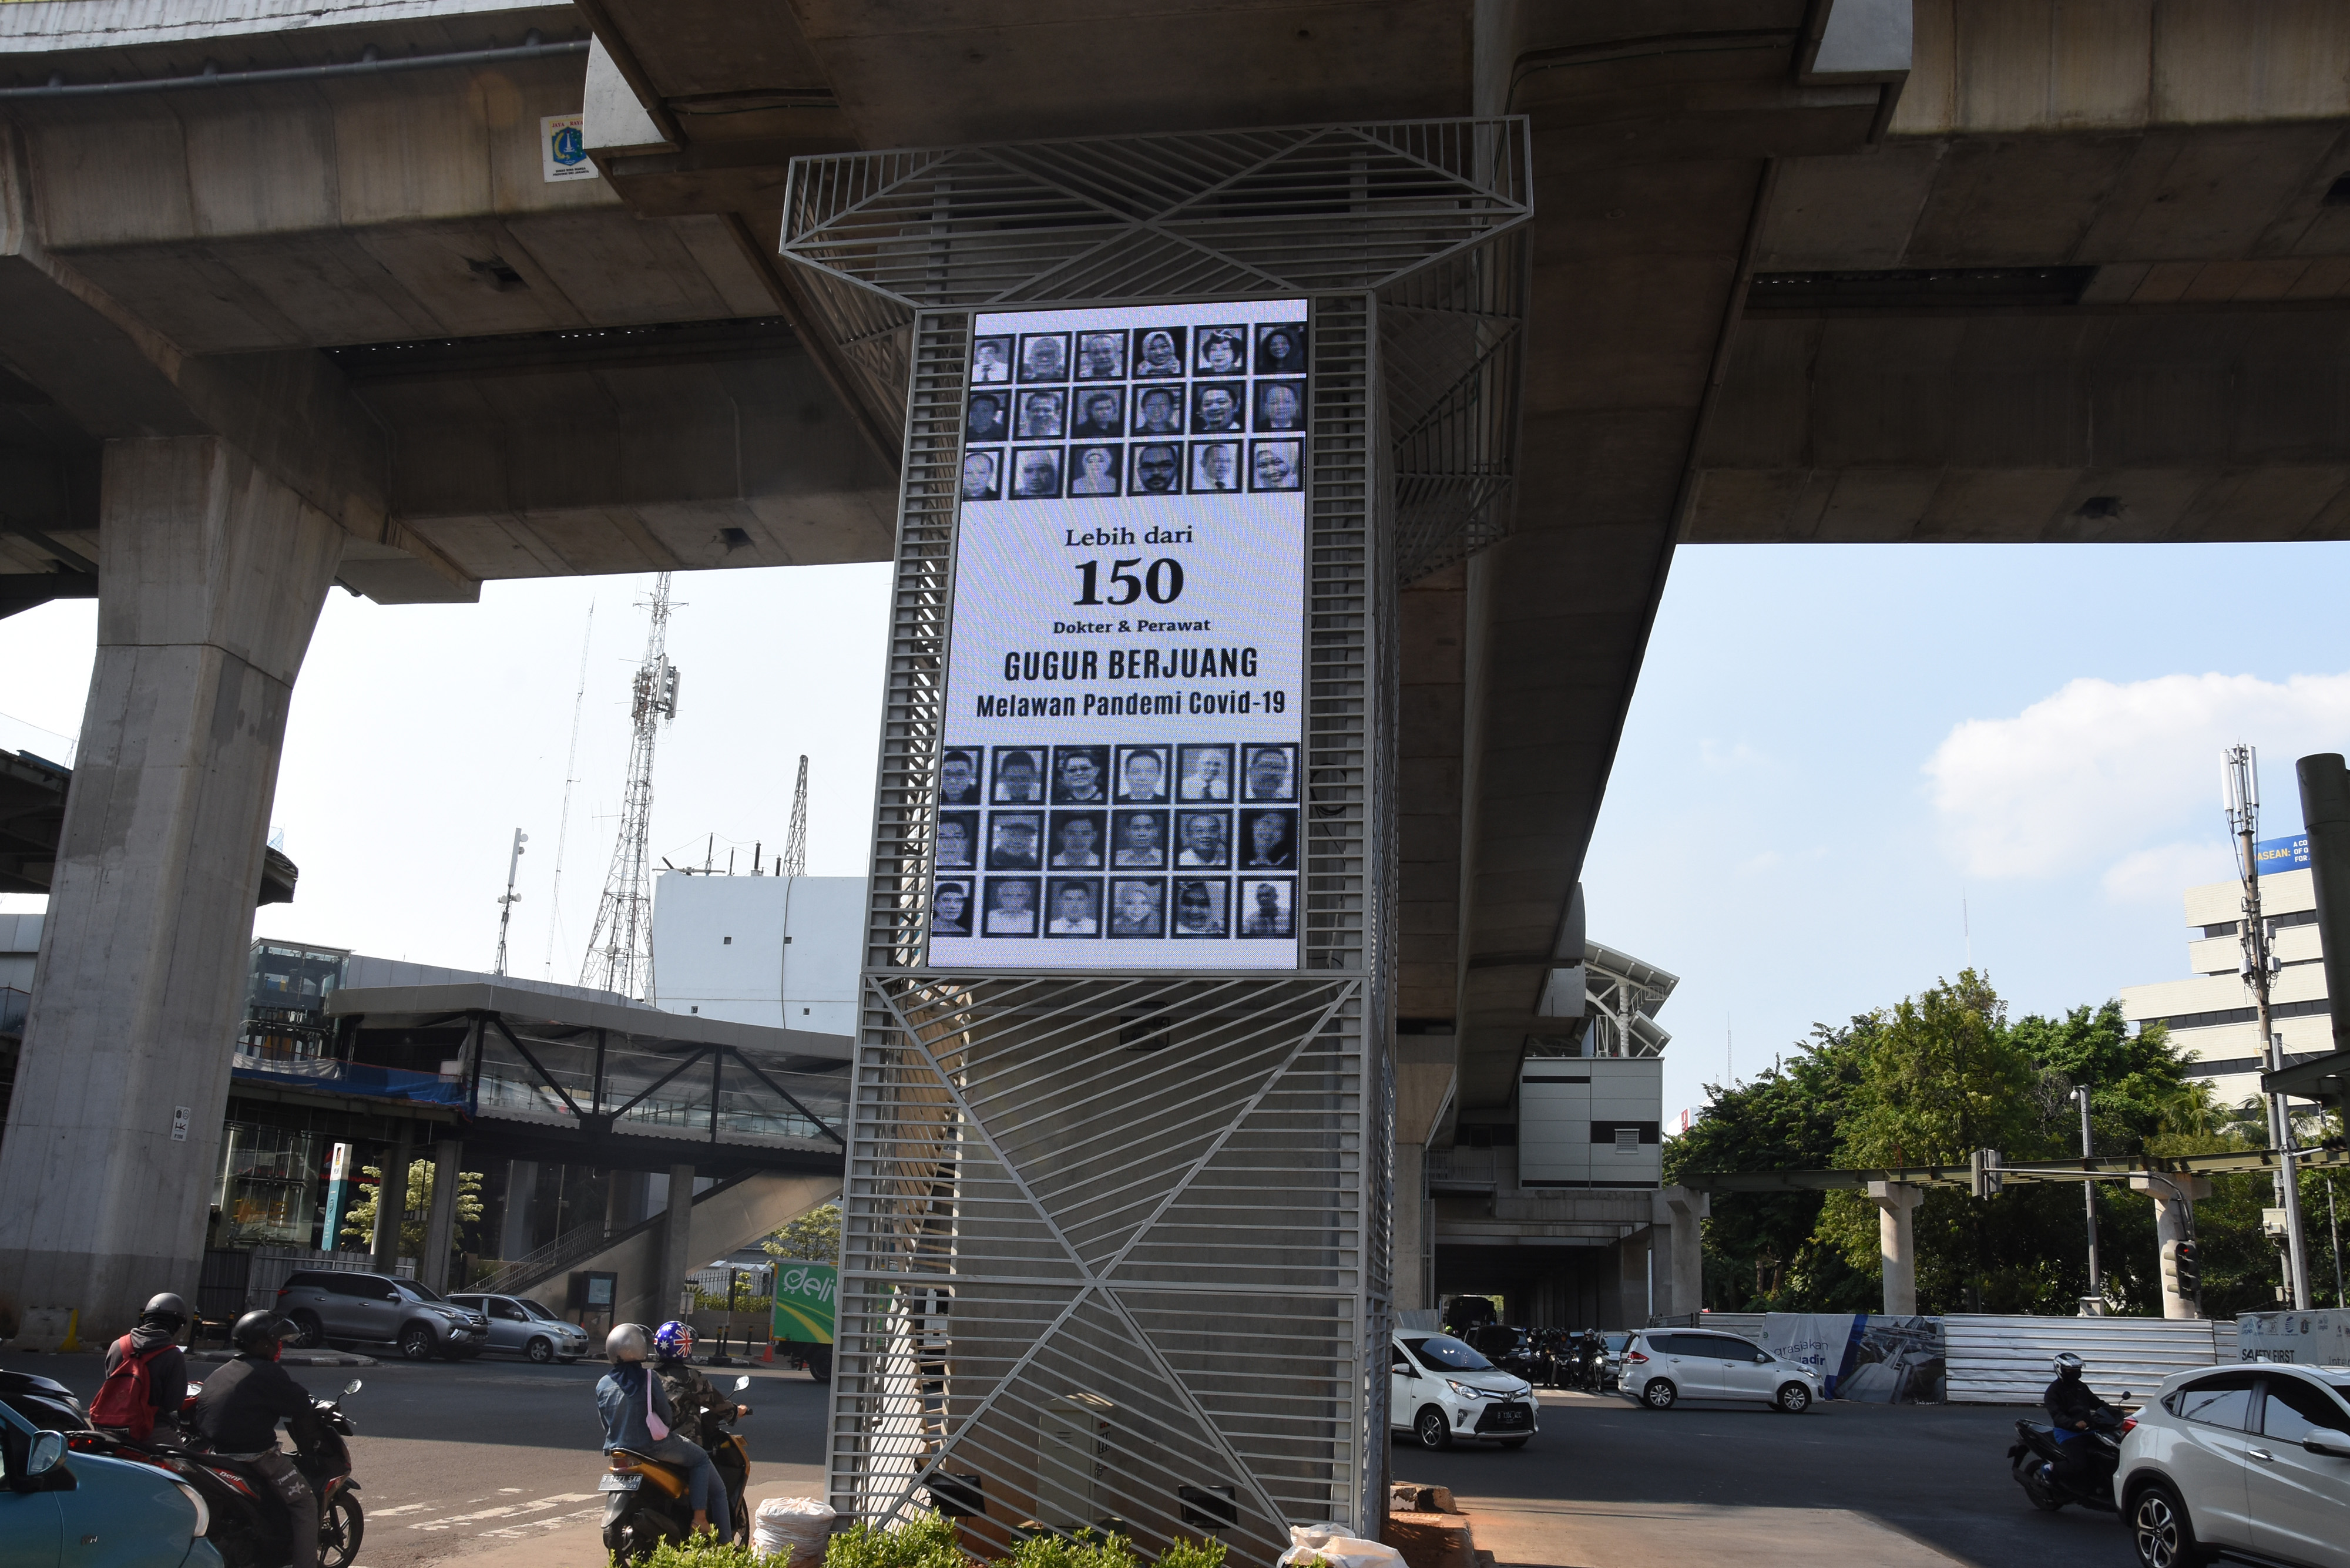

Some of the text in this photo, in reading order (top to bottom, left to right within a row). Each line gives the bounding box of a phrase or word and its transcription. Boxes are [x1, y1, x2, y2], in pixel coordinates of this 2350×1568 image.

[1066, 525, 1193, 547] Lebih dari
[1073, 558, 1184, 606] 150
[1053, 619, 1211, 634] Dokter & Perawat
[1004, 647, 1257, 681] GUGUR BERJUANG
[976, 690, 1285, 717] Melawan Pandemi Covid-19
[2257, 848, 2291, 861] ASEAN:
[2273, 1350, 2294, 1364] FIRST
